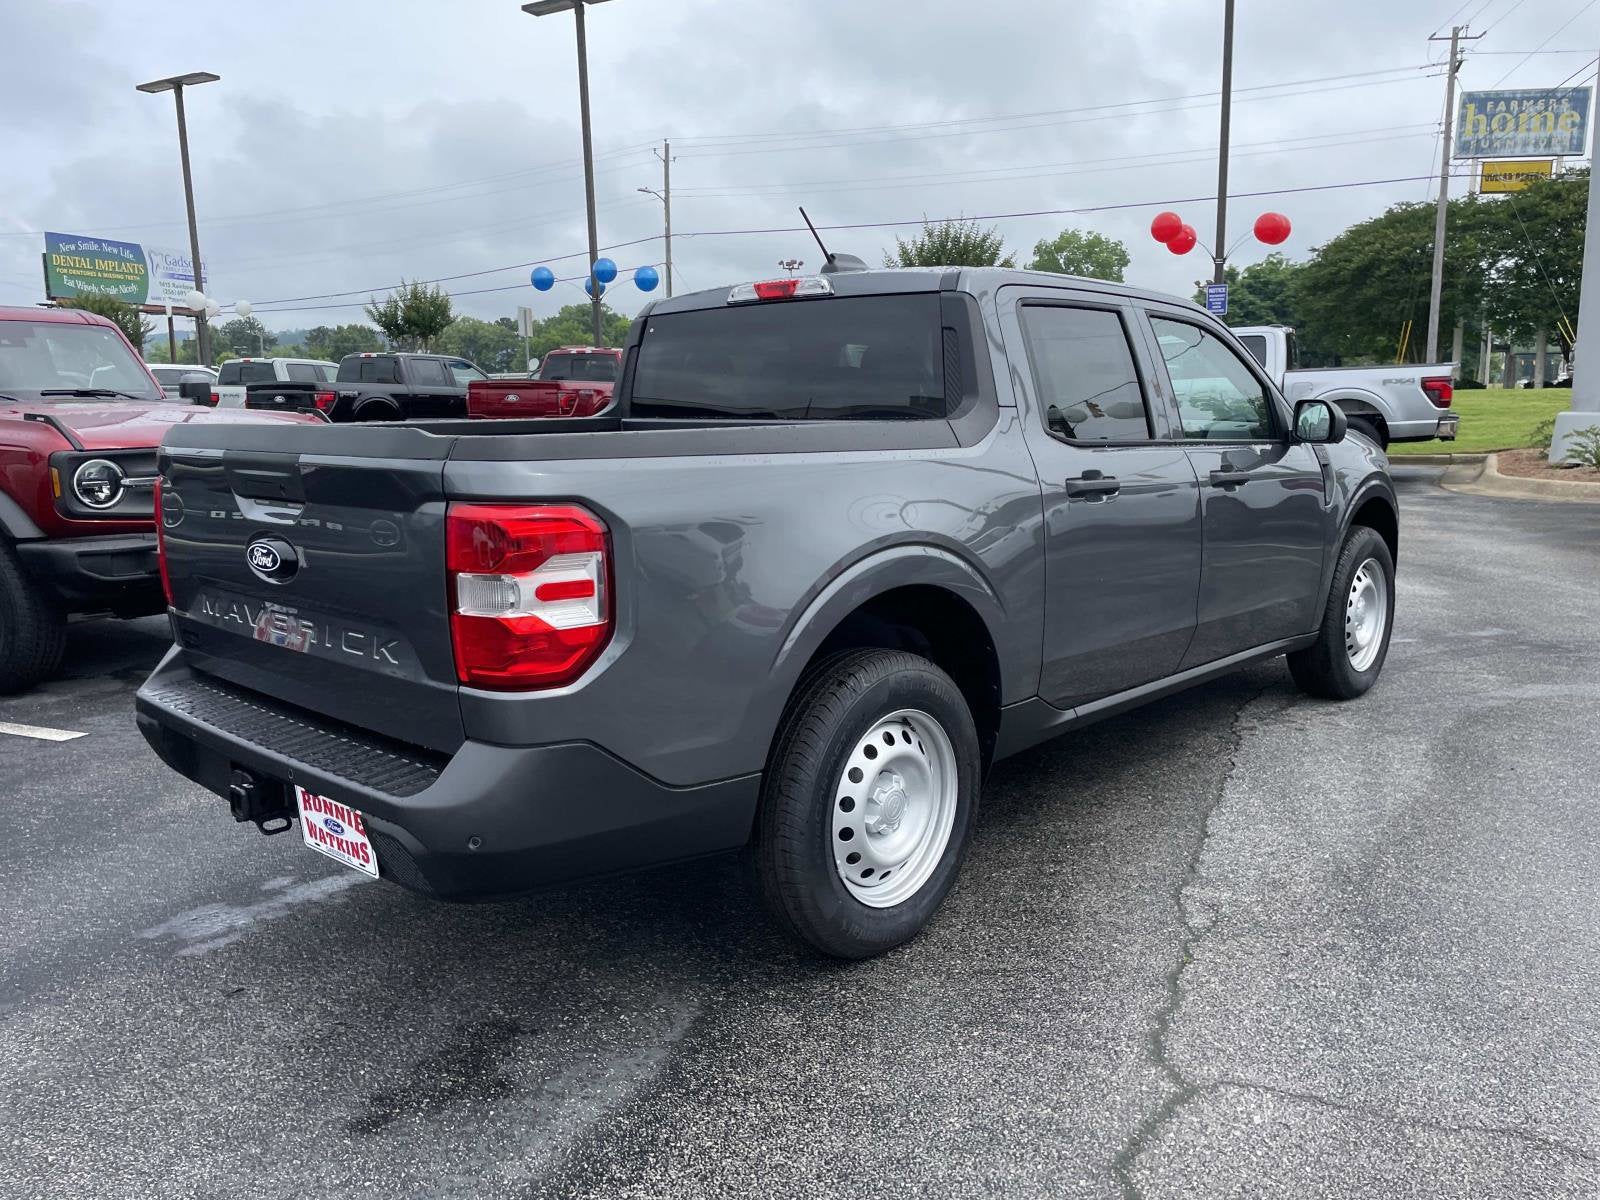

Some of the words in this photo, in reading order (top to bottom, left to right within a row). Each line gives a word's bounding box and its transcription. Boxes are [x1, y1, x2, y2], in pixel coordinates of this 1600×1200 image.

[1486, 98, 1571, 113] FARMERS
[1464, 103, 1581, 137] home
[59, 242, 76, 253] New
[77, 240, 101, 252] Smile.
[102, 242, 119, 255] New
[52, 254, 93, 269] DENTAL
[95, 258, 145, 275] IMPLANTS
[69, 269, 97, 277] DENTURES
[103, 272, 124, 280] MISSING
[63, 275, 75, 288] Eat
[252, 547, 273, 567] Ford
[200, 595, 400, 665] MAVERICK
[301, 789, 367, 838] RONNIE
[325, 818, 343, 834] Ford
[304, 815, 371, 865] WATKINS
